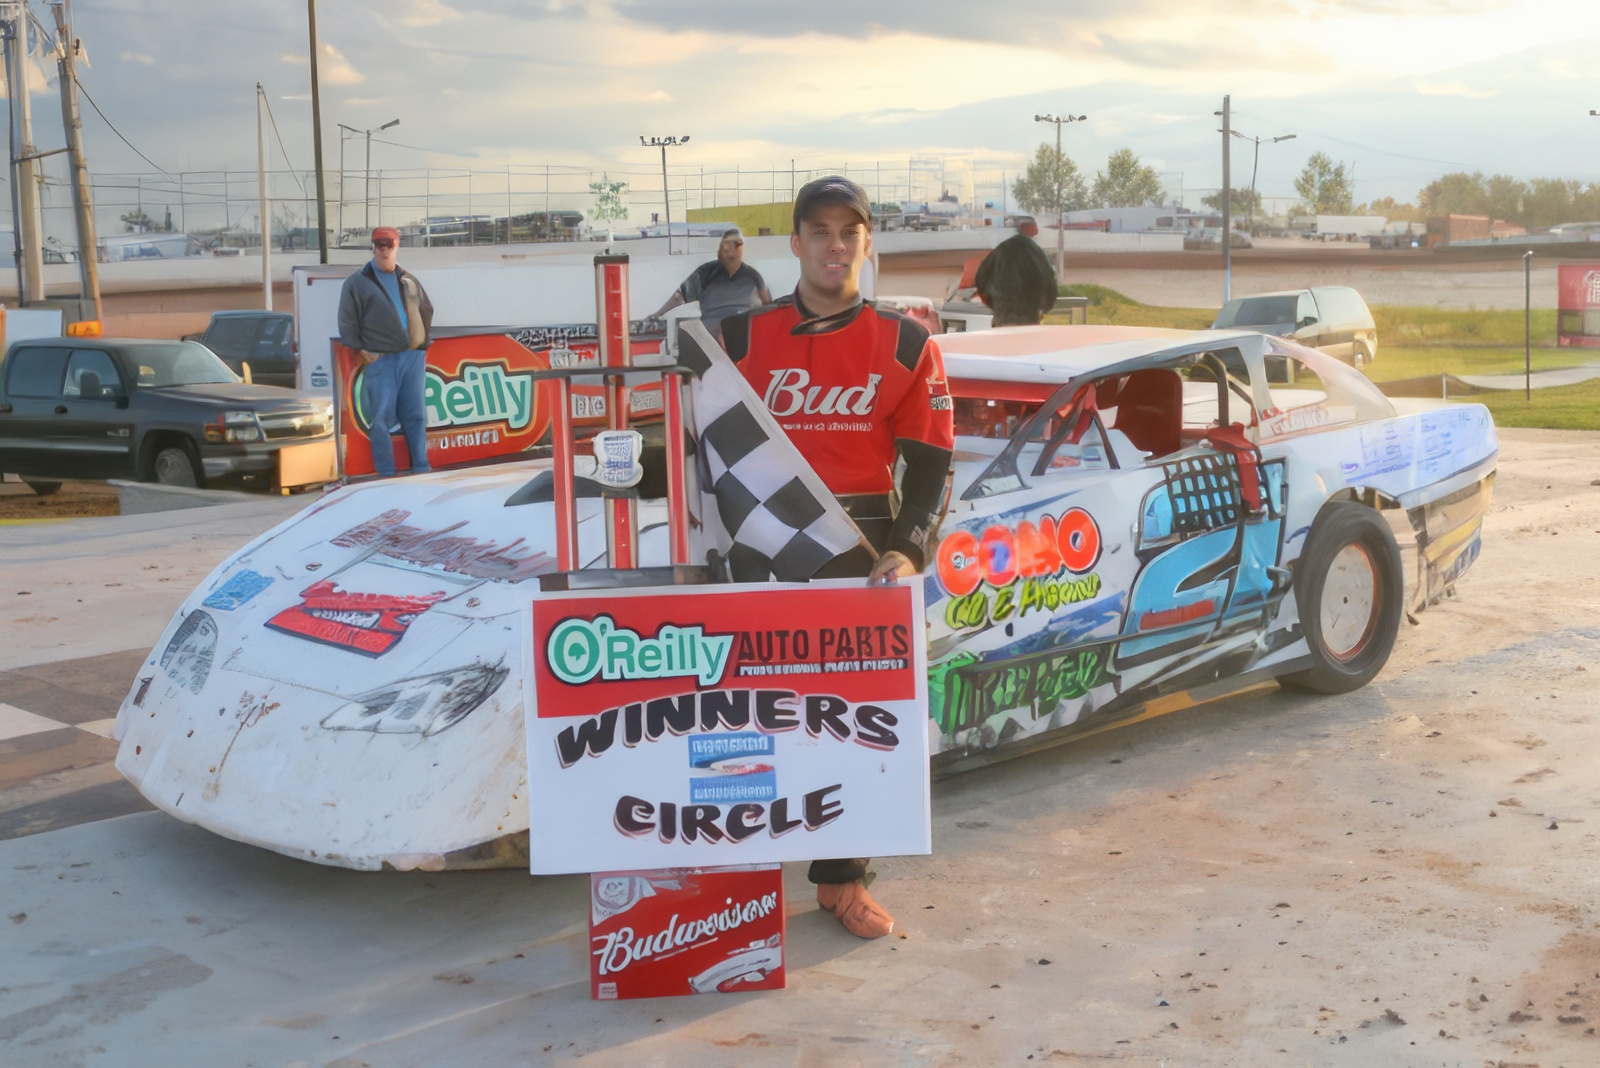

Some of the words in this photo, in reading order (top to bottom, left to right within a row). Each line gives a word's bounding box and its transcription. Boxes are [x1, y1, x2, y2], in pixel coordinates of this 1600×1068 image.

[763, 367, 883, 417] Bud
[551, 617, 732, 683] O'Reilly
[737, 630, 809, 662] AUTO
[819, 624, 910, 660] PARTS
[554, 689, 900, 768] WINNERS
[613, 783, 844, 845] CIRCLE
